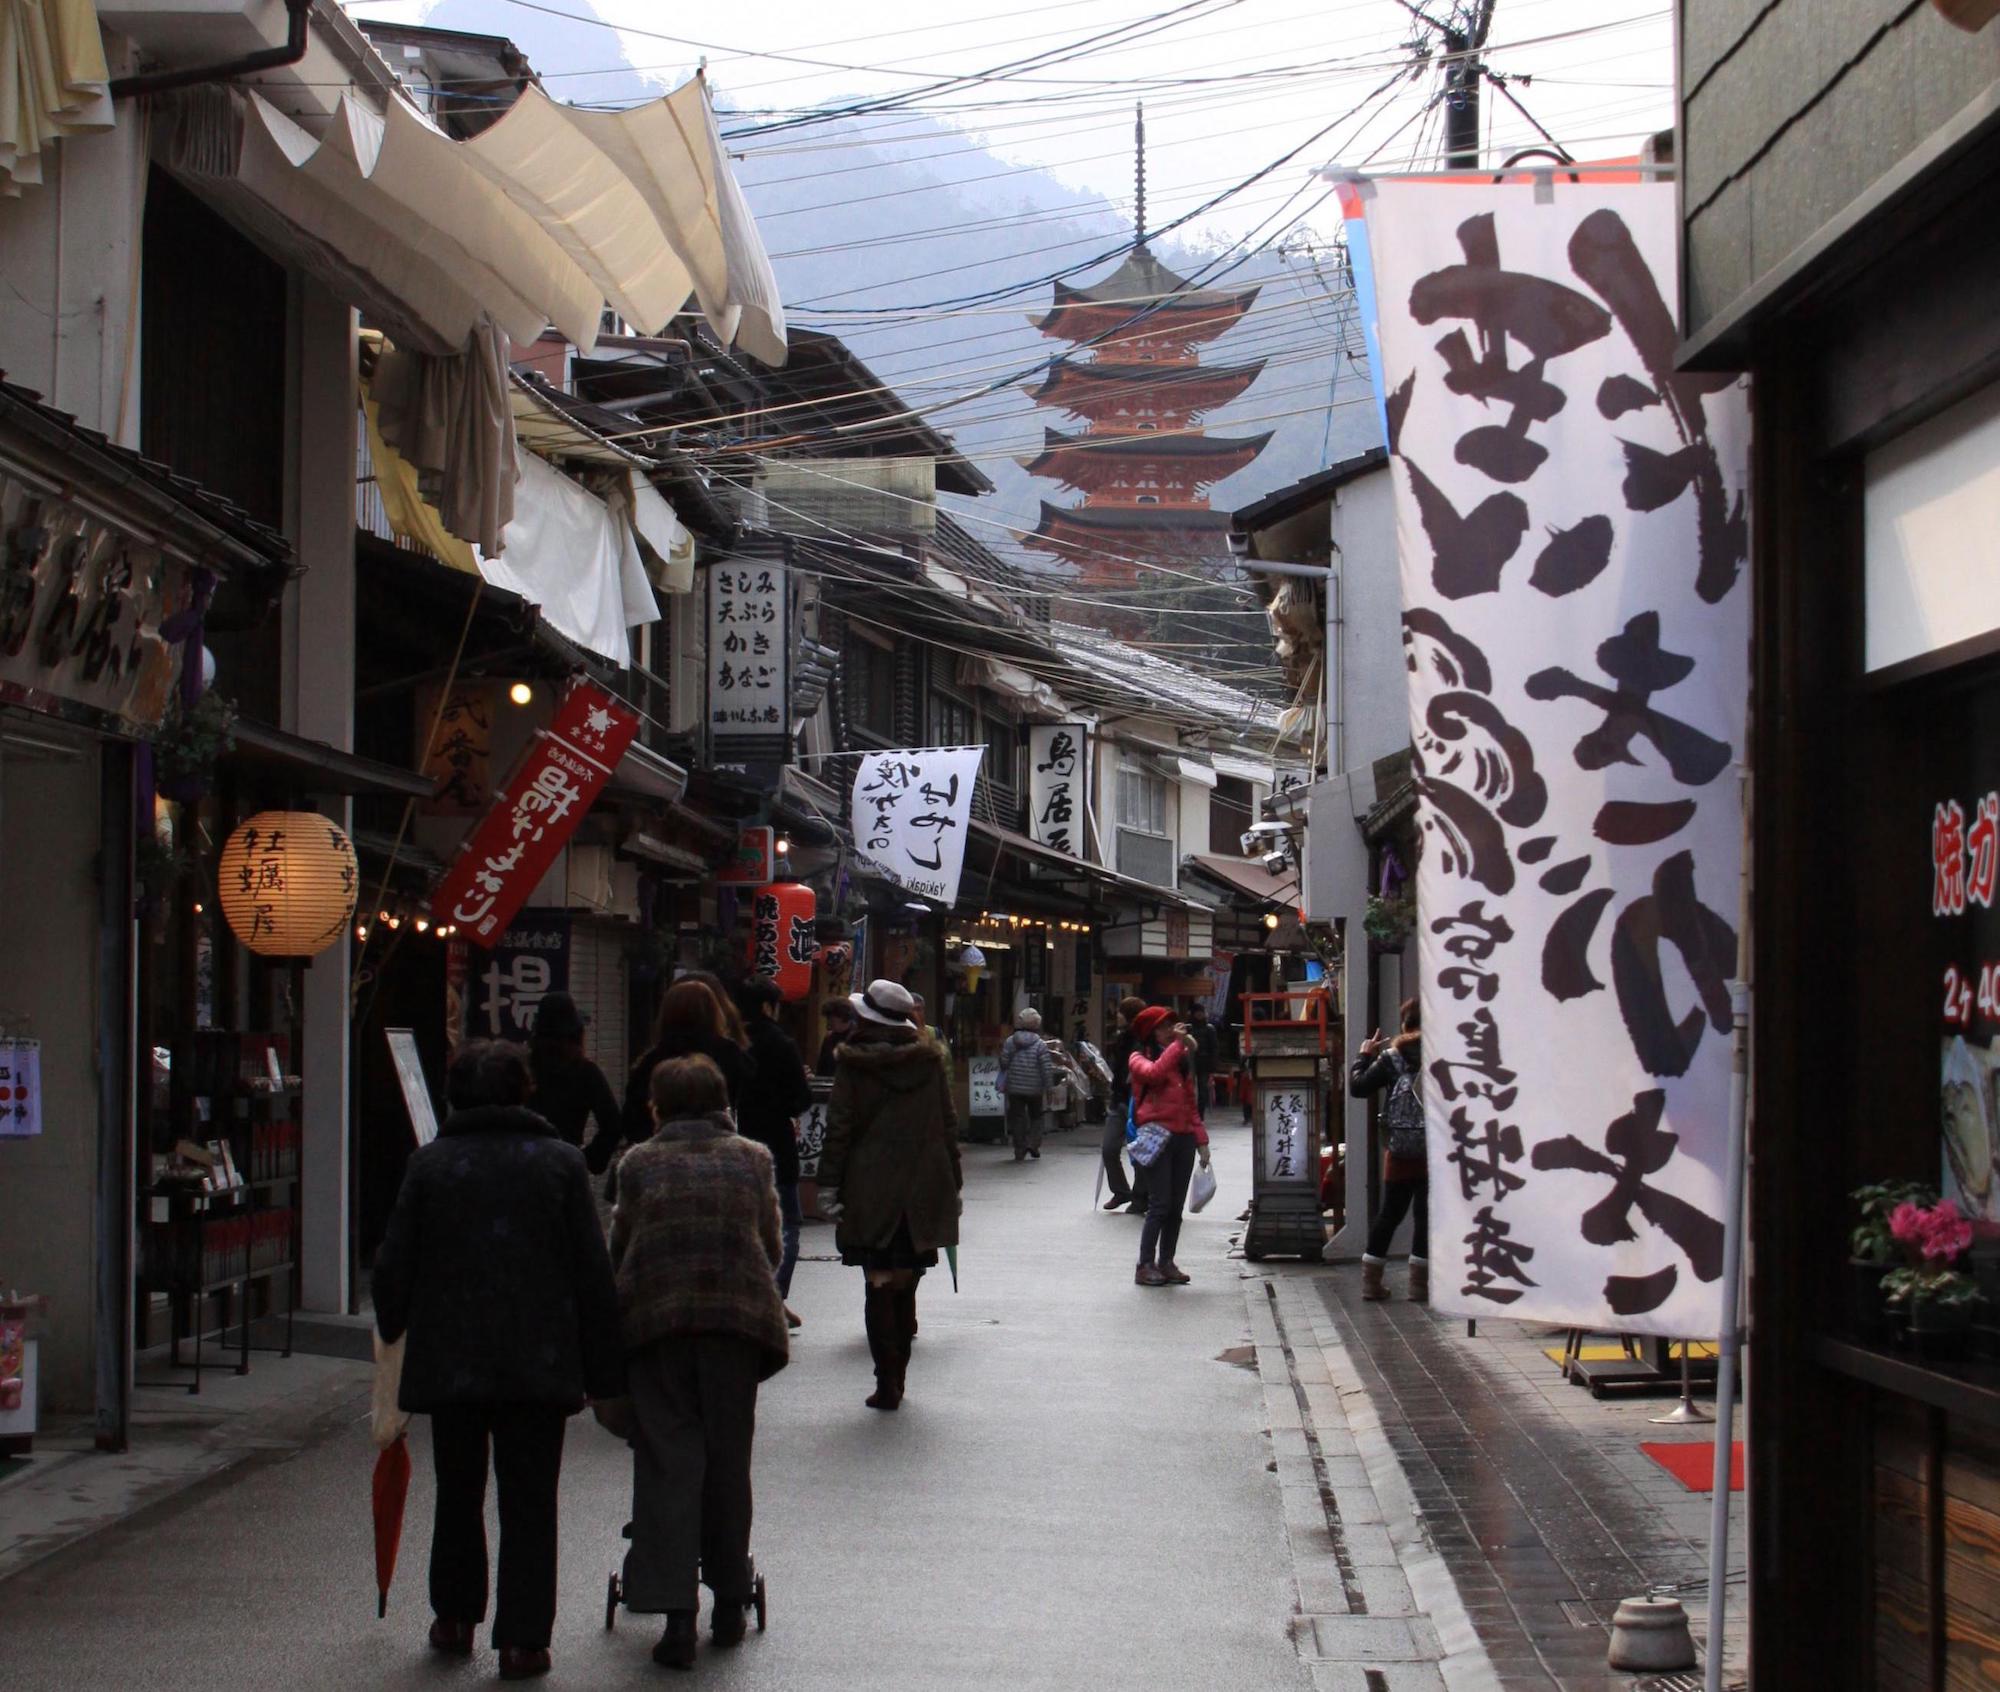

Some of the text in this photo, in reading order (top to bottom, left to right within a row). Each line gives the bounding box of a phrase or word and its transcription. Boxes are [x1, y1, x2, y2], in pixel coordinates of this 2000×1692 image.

[718, 571, 776, 594] さしみ
[718, 600, 776, 623] 天ぷら
[723, 630, 770, 655] かき
[718, 661, 777, 690] あなご
